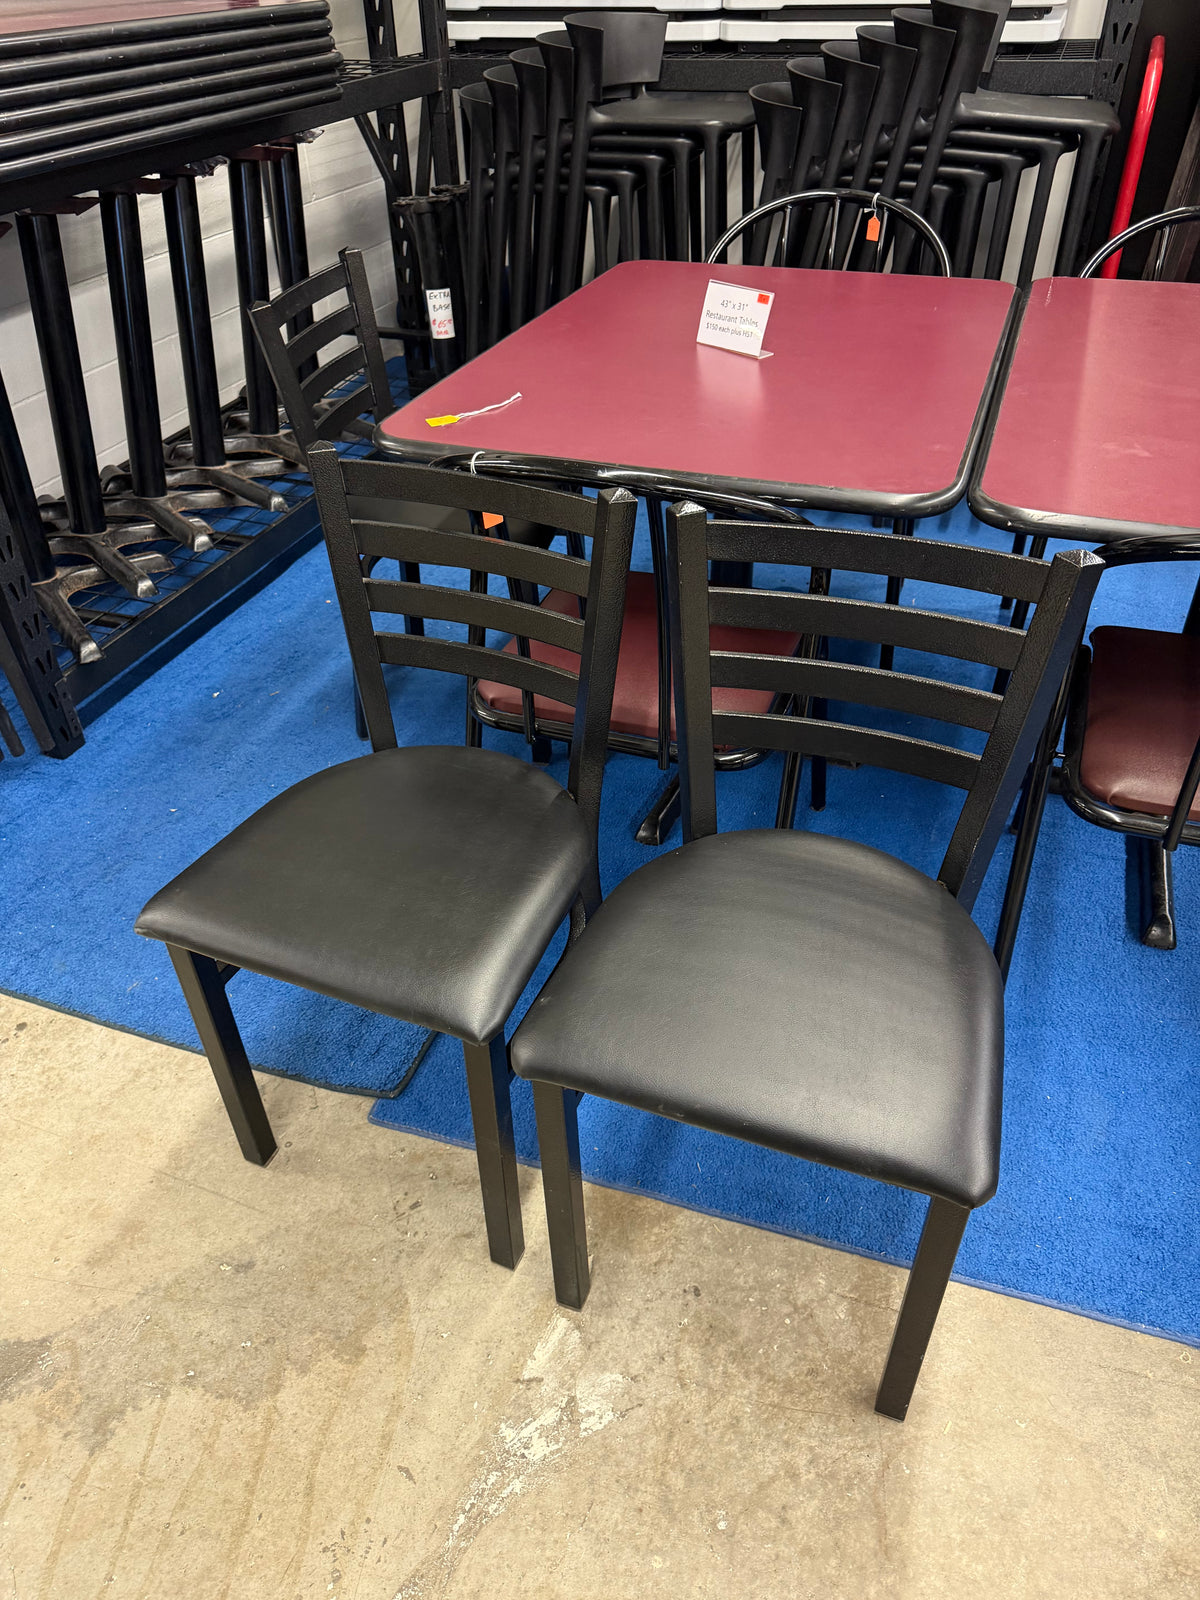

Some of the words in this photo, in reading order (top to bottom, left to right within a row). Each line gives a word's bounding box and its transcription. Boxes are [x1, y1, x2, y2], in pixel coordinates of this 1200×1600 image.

[706, 310, 738, 324] Restaurant
[706, 322, 718, 330] $150
[731, 328, 741, 336] plus
